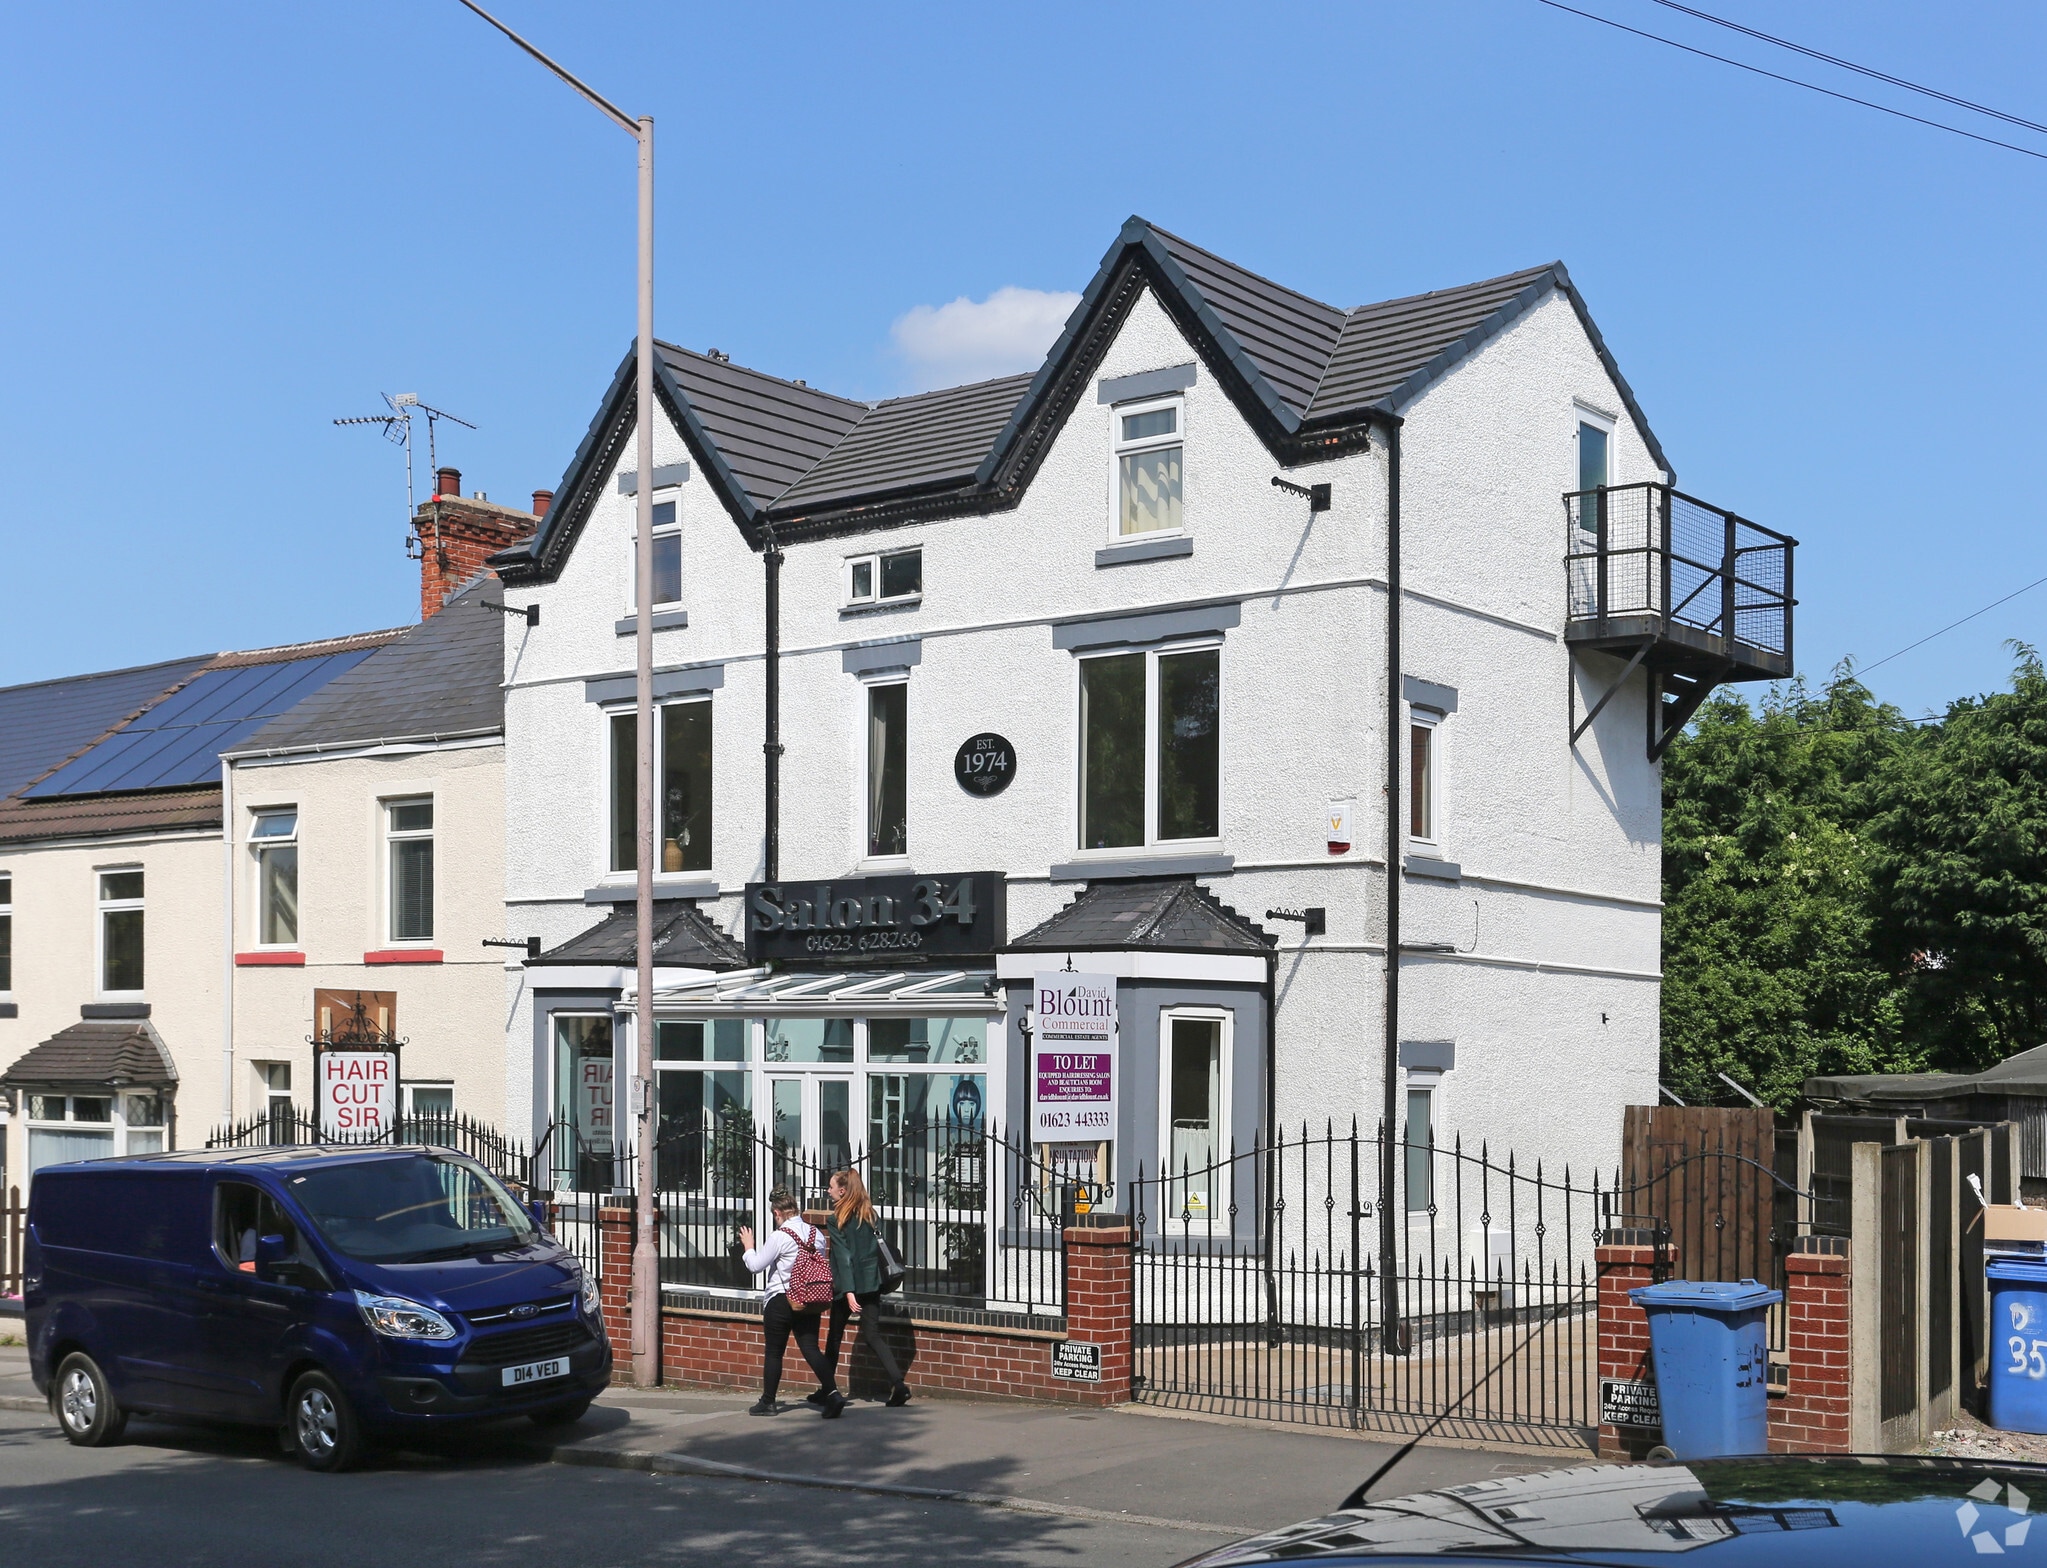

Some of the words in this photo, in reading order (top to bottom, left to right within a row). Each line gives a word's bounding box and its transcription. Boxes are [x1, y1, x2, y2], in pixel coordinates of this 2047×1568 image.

[976, 738, 995, 750] EST.
[963, 751, 1008, 773] 1974
[752, 886, 899, 932] Salon
[910, 878, 977, 926] 34
[806, 935, 851, 951] 01623
[858, 932, 922, 951] 628260
[1078, 986, 1106, 998] David
[1039, 989, 1112, 1016] Blount
[1042, 1017, 1108, 1031] Commercial
[1053, 1055, 1071, 1070] TO
[1074, 1055, 1097, 1070] LET
[327, 1060, 388, 1081] HAIR
[332, 1084, 384, 1104] CUT
[337, 1107, 379, 1128] SIR
[1040, 1112, 1071, 1128] 01623
[1075, 1111, 1109, 1127] 443333
[1060, 1344, 1091, 1354] PRIVATE
[1059, 1352, 1092, 1362] PARKING
[514, 1367, 532, 1381] D14
[537, 1361, 559, 1377] VED
[1054, 1367, 1072, 1375] KEEP
[1075, 1370, 1097, 1378] CLEAR
[1612, 1384, 1656, 1396] PRIVATE
[1611, 1393, 1656, 1406] PARKING
[1604, 1410, 1629, 1422] KEEP
[1632, 1414, 1661, 1425] CLEA
[1639, 1406, 1660, 1415] Requir
